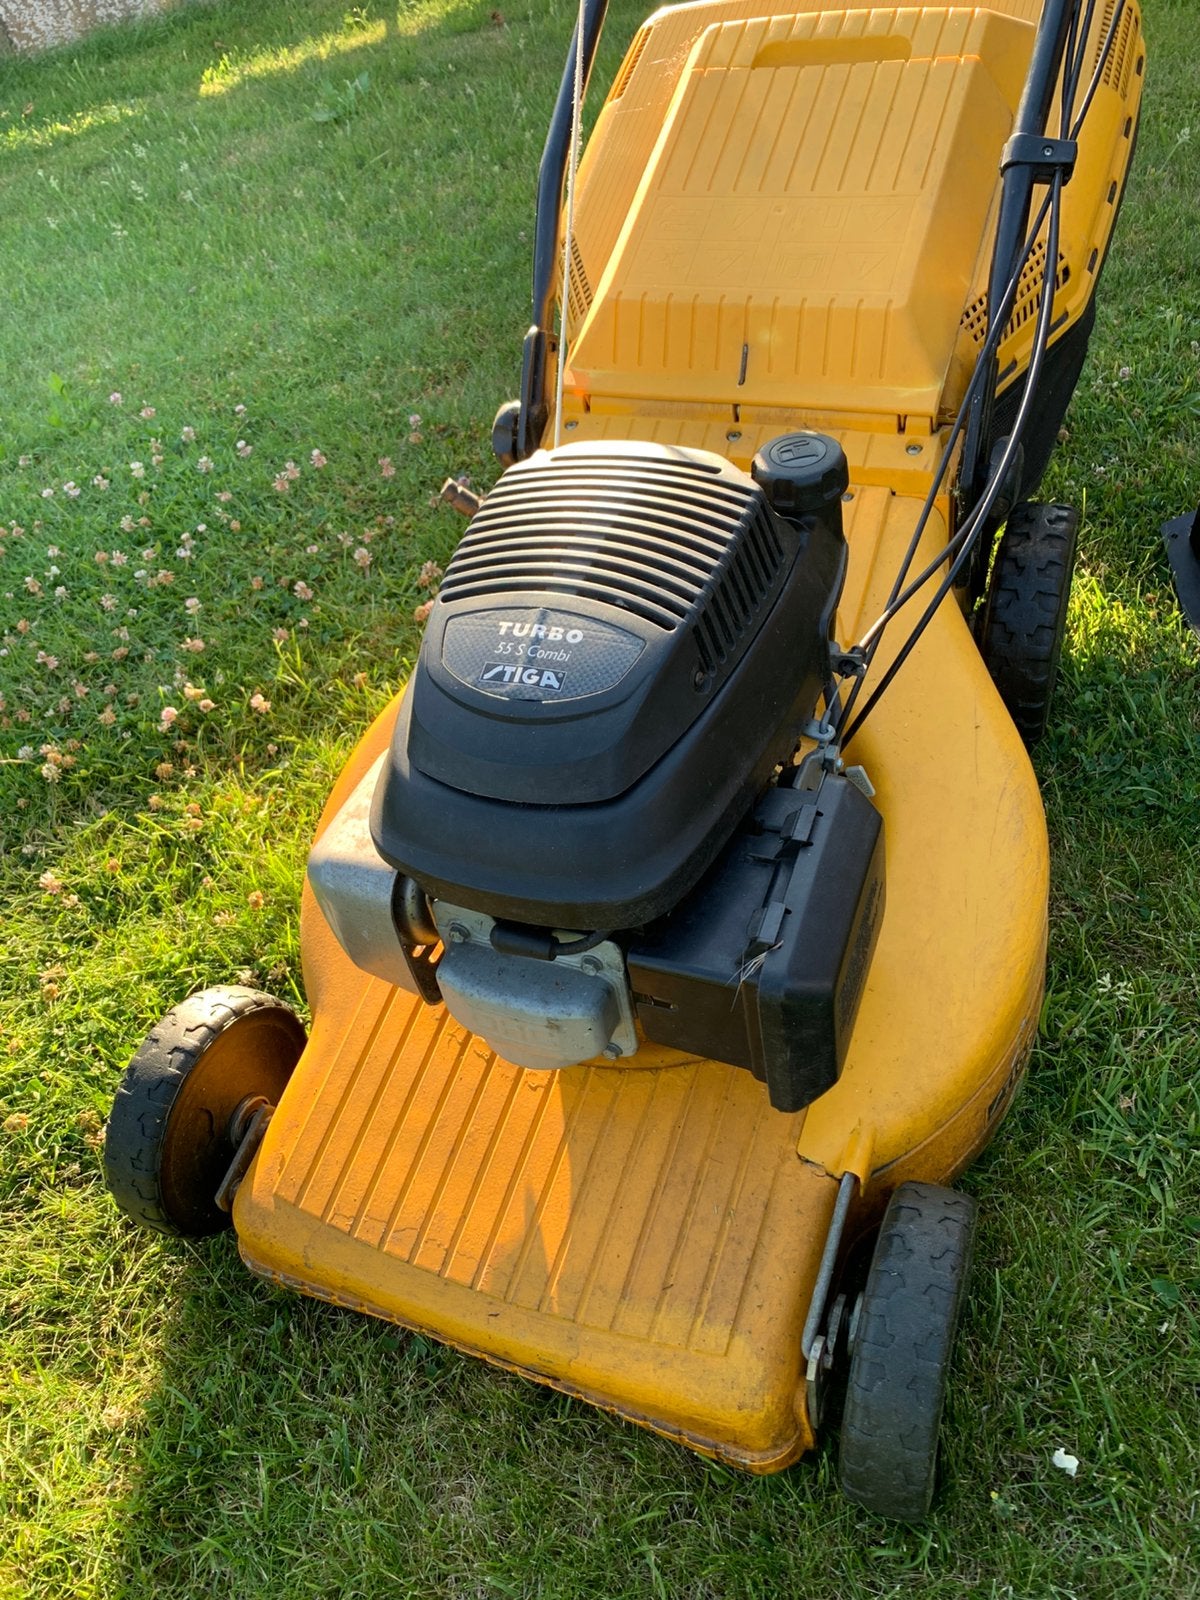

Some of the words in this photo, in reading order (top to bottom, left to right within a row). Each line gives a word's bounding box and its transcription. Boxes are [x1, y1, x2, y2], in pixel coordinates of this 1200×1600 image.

[498, 621, 584, 644] TURBO
[494, 641, 515, 655] 55
[515, 643, 526, 656] S
[527, 645, 572, 662] Combi
[483, 665, 561, 689] STIGA
